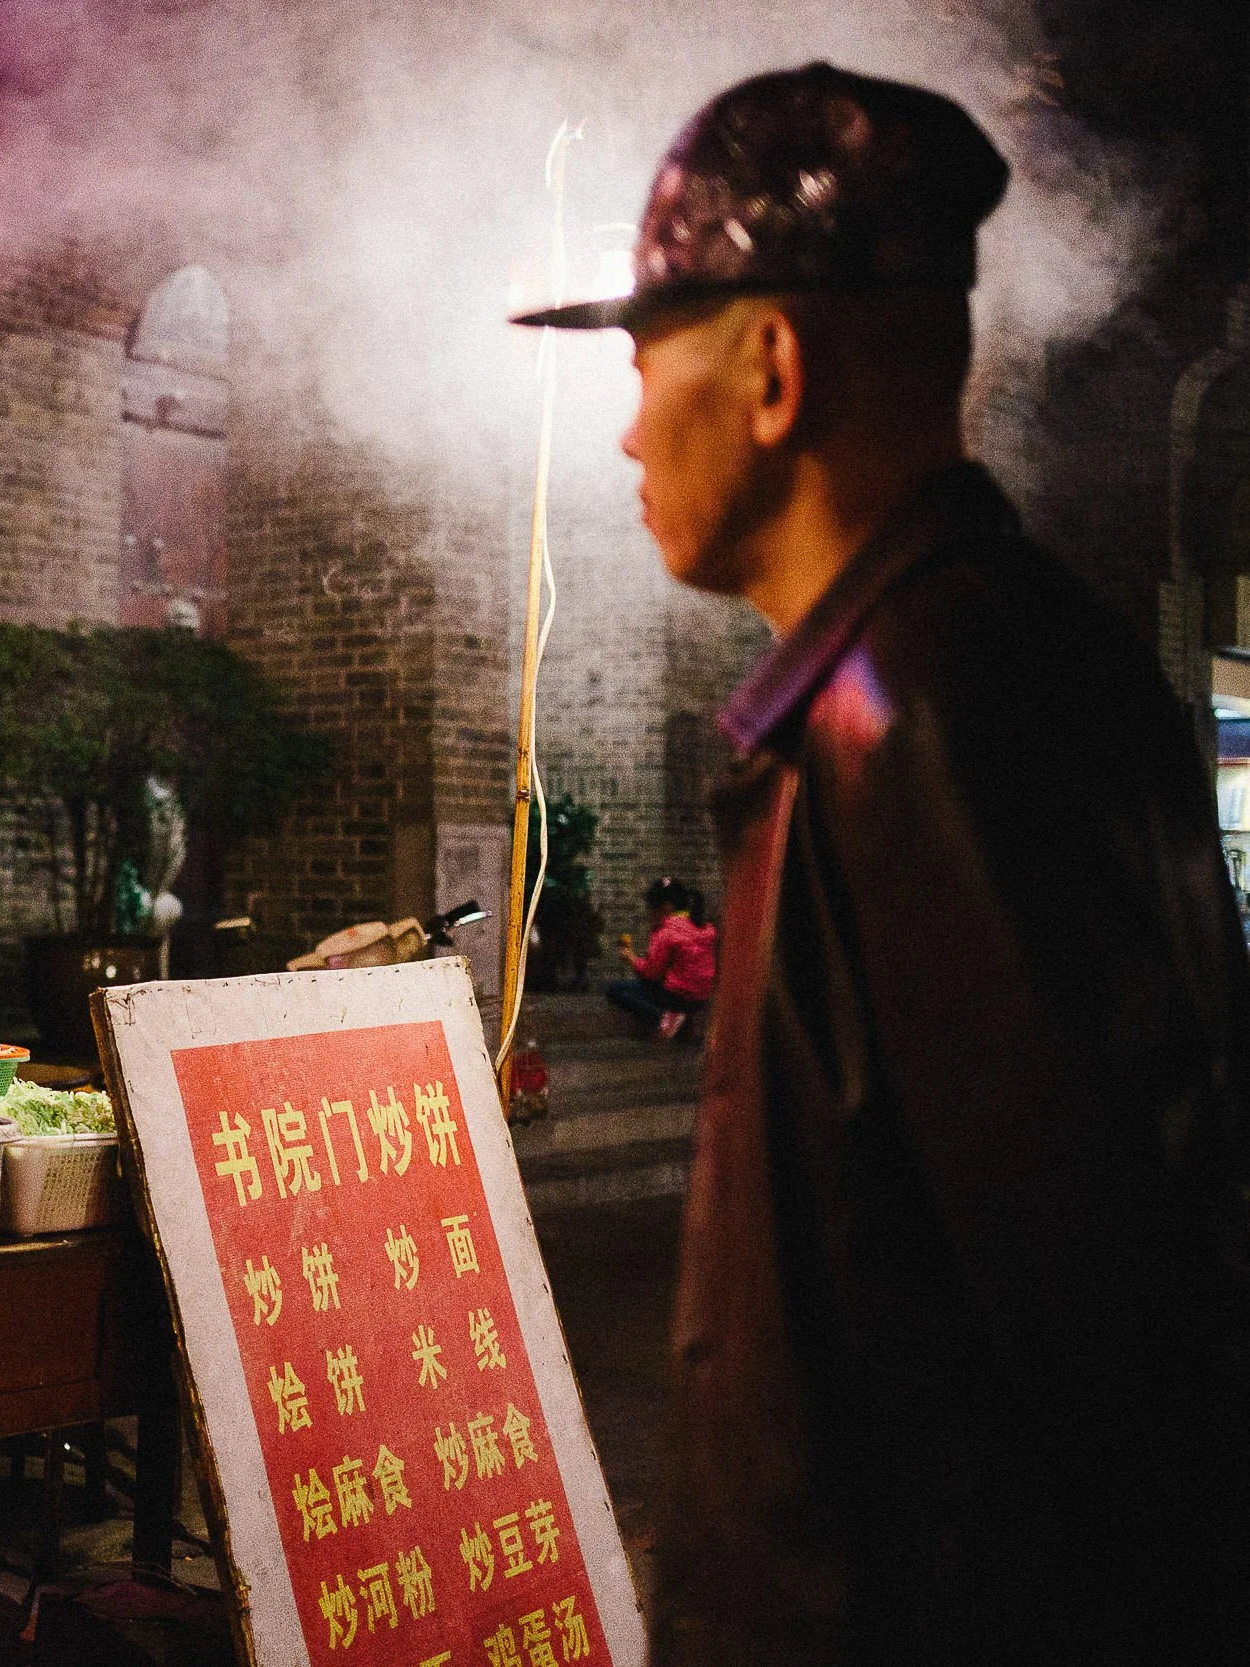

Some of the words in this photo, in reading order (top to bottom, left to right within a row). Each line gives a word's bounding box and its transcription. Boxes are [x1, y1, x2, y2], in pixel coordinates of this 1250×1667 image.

[211, 1080, 462, 1206] 书院门炒饼
[243, 1242, 341, 1326] 炒饼
[384, 1214, 480, 1290] 炒面
[267, 1345, 366, 1434] 烩饼
[411, 1308, 508, 1390] 米线
[292, 1444, 412, 1543] 烩麻食
[433, 1402, 539, 1491] 炒麻食
[318, 1546, 435, 1649] 炒河粉
[460, 1499, 560, 1592] 炒豆芽
